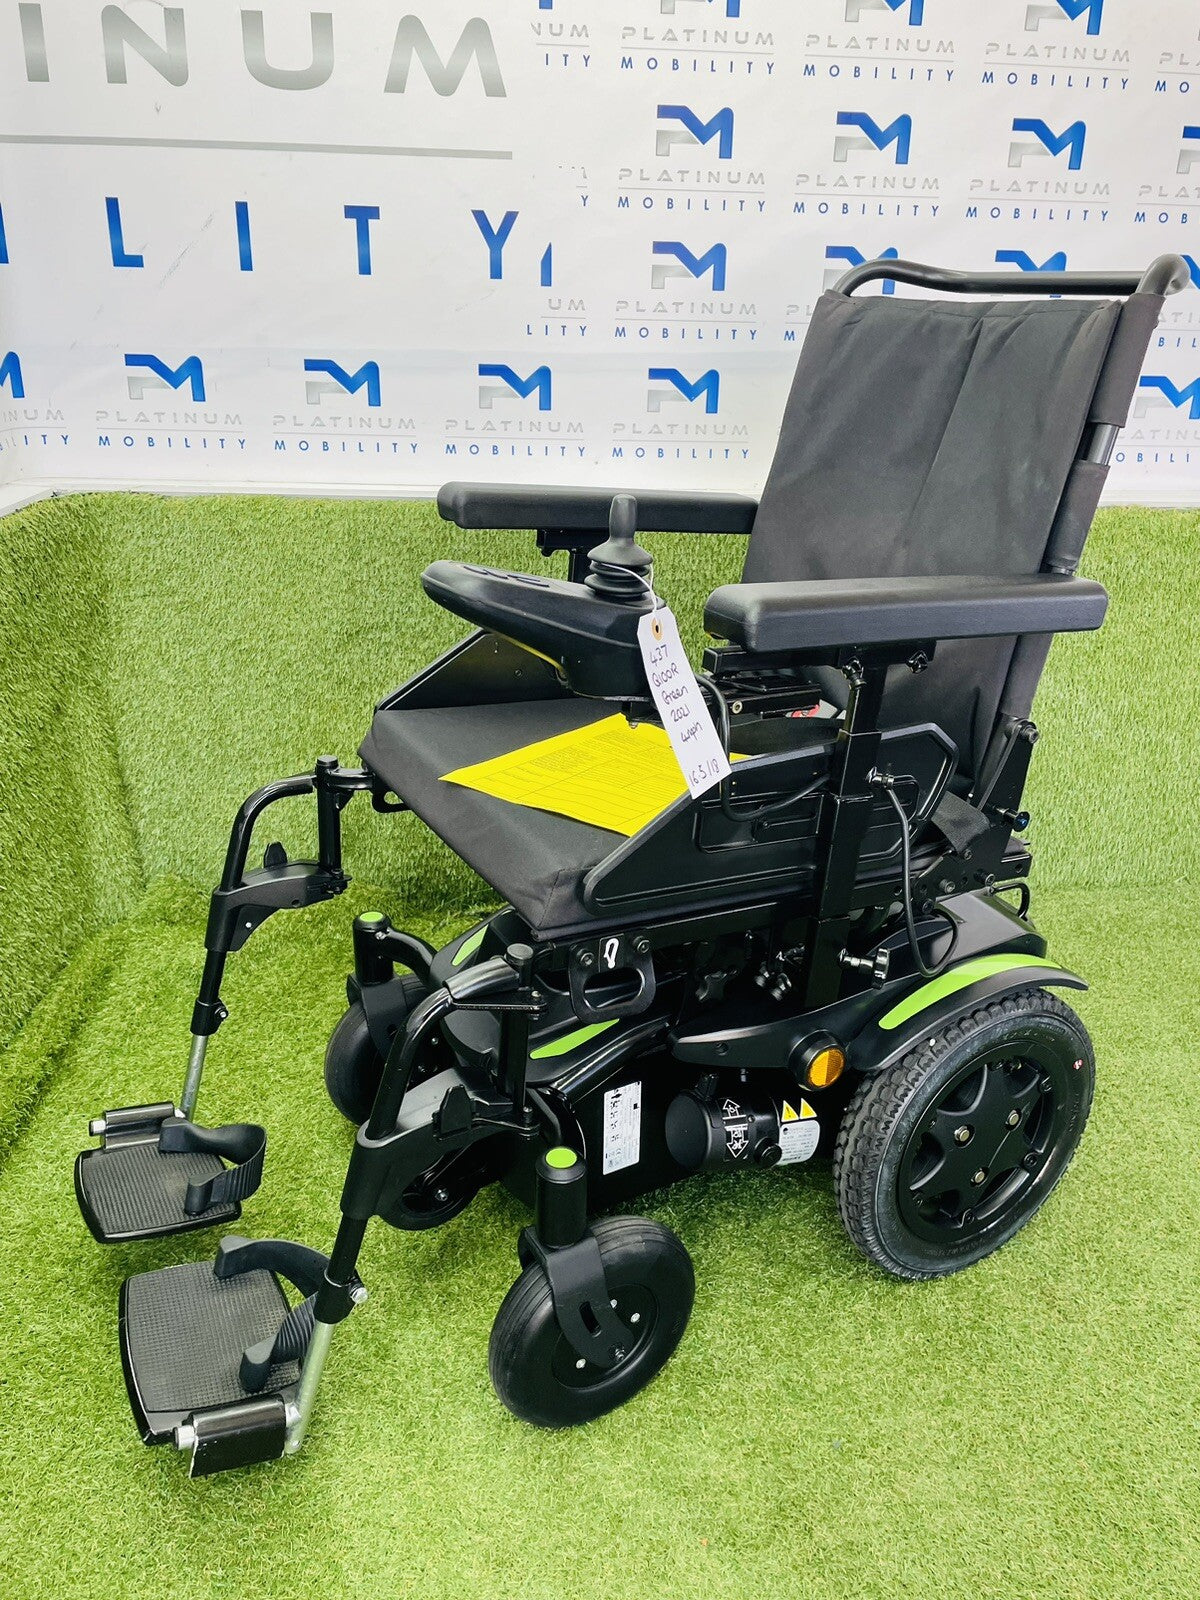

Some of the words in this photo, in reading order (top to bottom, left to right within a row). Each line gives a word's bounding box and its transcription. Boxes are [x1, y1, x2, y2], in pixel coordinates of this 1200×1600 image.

[622, 27, 774, 45] PLATINUM
[806, 34, 954, 53] PLATINUM
[986, 43, 1129, 62] PLATINUM
[621, 57, 774, 74] MOBILITY
[804, 64, 953, 81] MOBILITY
[982, 72, 1128, 89] MOBILITY
[619, 168, 765, 185] PLATINUM
[796, 174, 939, 189] PLATINUM
[970, 179, 1109, 195] PLATINUM
[618, 197, 765, 212] MOBILITY
[793, 202, 939, 216] MOBILITY
[966, 207, 1108, 221] MOBILITY
[616, 301, 756, 316] PLATINUM
[615, 327, 757, 340] MOBILITY
[96, 411, 242, 425] PLATINUM
[273, 415, 415, 429] PLATINUM
[446, 420, 583, 433] PLATINUM
[613, 423, 748, 435] PLATINUM
[99, 436, 245, 449] MOBILITY
[275, 440, 417, 453] MOBILITY
[446, 444, 585, 456] MOBILITY
[612, 447, 748, 458] MOBILITY
[650, 644, 668, 667] 437
[671, 704, 690, 722] 2021
